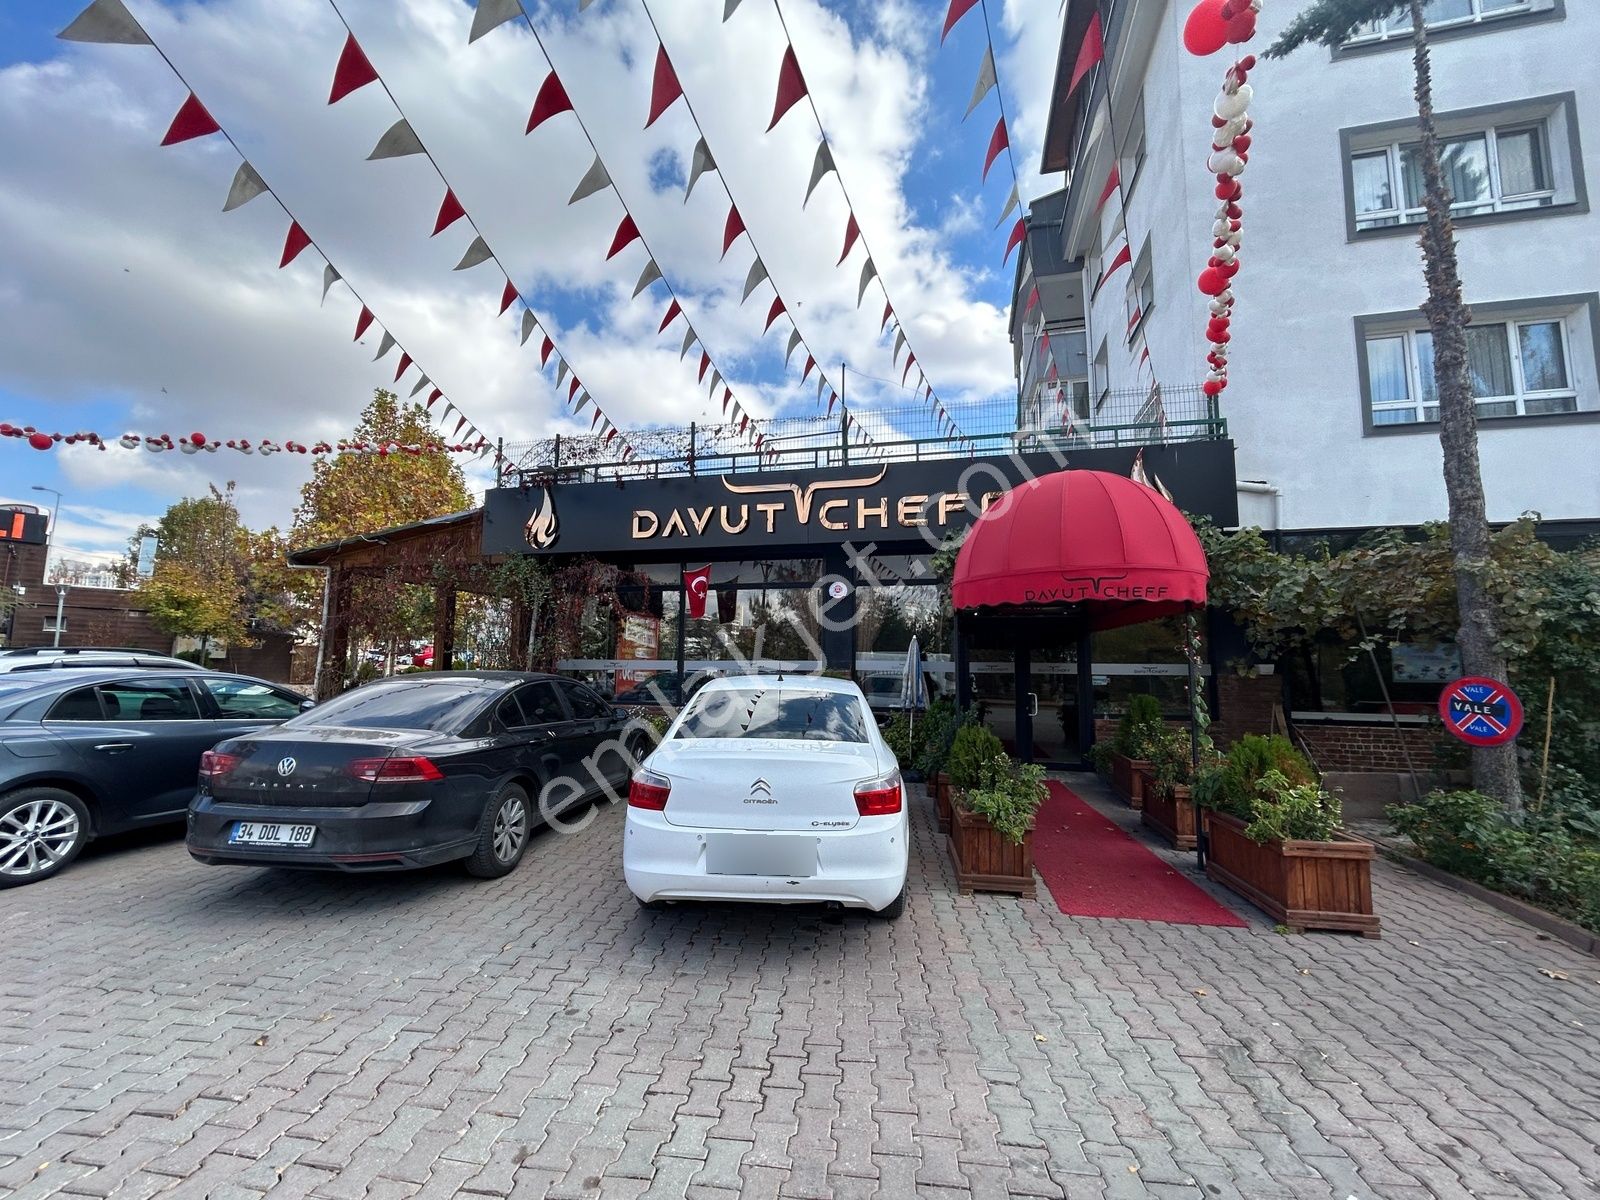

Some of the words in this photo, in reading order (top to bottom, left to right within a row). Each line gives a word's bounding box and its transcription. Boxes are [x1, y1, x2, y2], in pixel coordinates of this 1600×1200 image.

[632, 502, 785, 539] DAVUT
[1025, 587, 1088, 601] DAVUT
[1103, 586, 1168, 598] CHEFF
[1464, 686, 1484, 694] VALE
[1454, 702, 1492, 715] VALE
[1469, 724, 1488, 733] VALE
[238, 823, 254, 839] 34
[258, 824, 281, 841] DDL
[288, 825, 313, 842] 188
